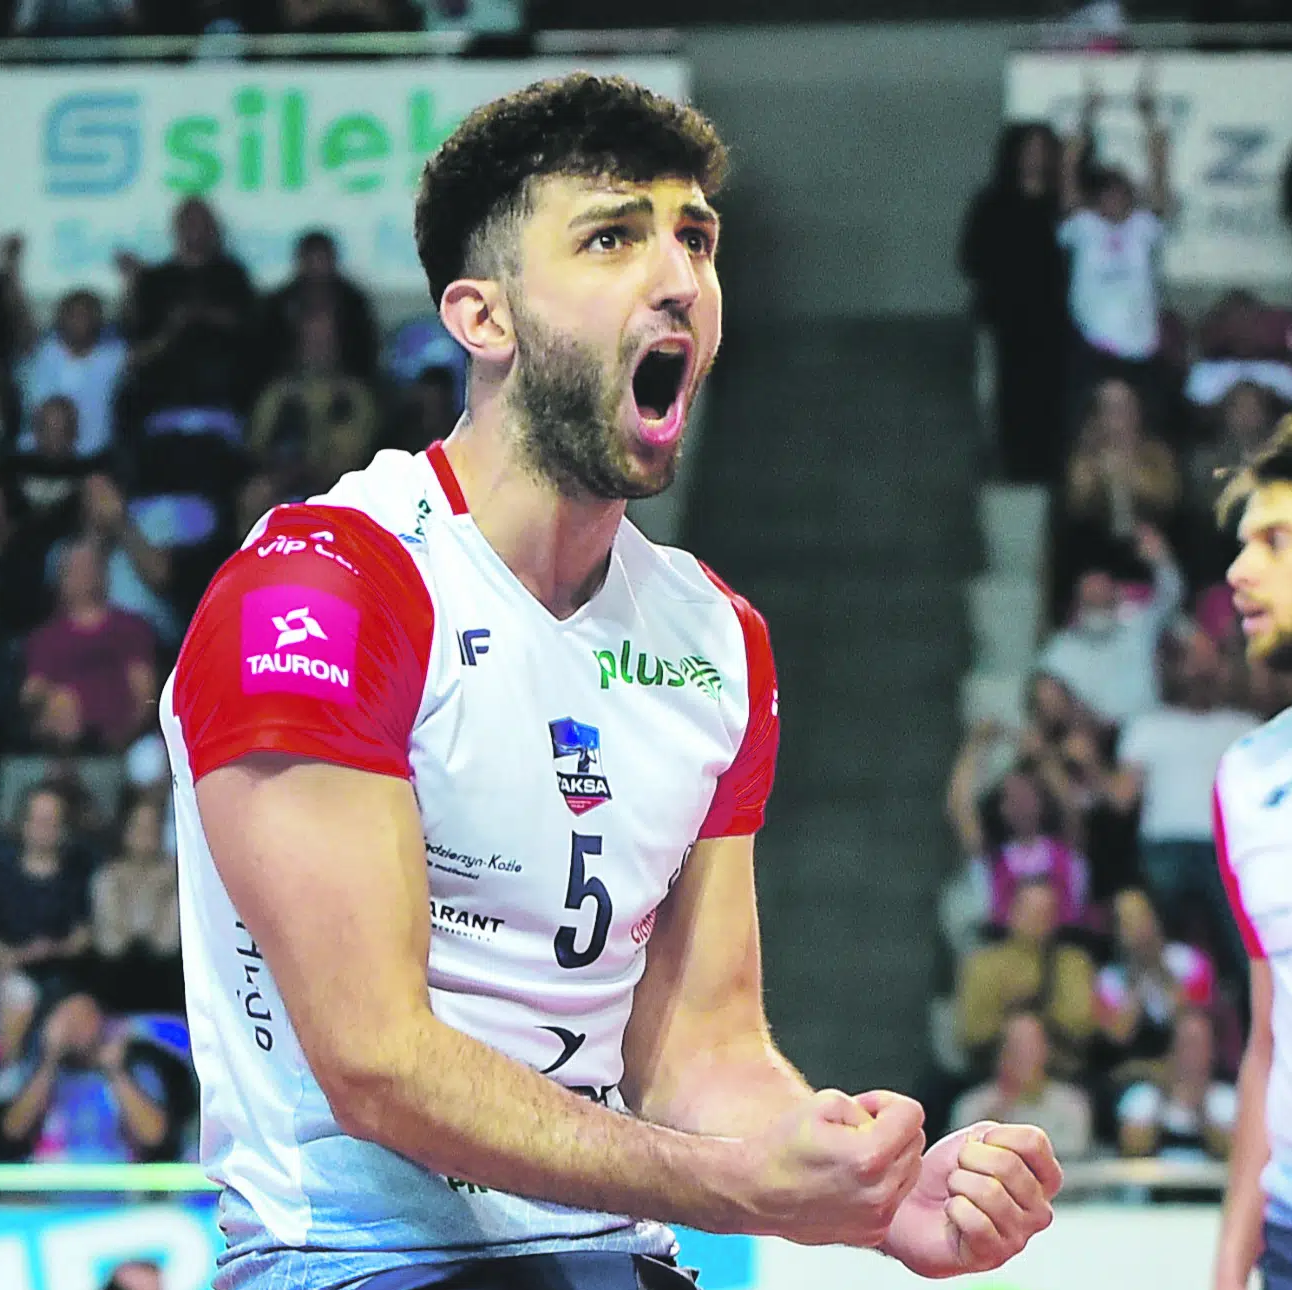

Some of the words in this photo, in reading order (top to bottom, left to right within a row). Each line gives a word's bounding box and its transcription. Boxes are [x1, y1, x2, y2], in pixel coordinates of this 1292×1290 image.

[163, 86, 448, 193] silek
[246, 652, 351, 688] TAURON
[593, 640, 688, 690] plus
[430, 900, 506, 934] ARANT
[554, 830, 613, 969] 5
